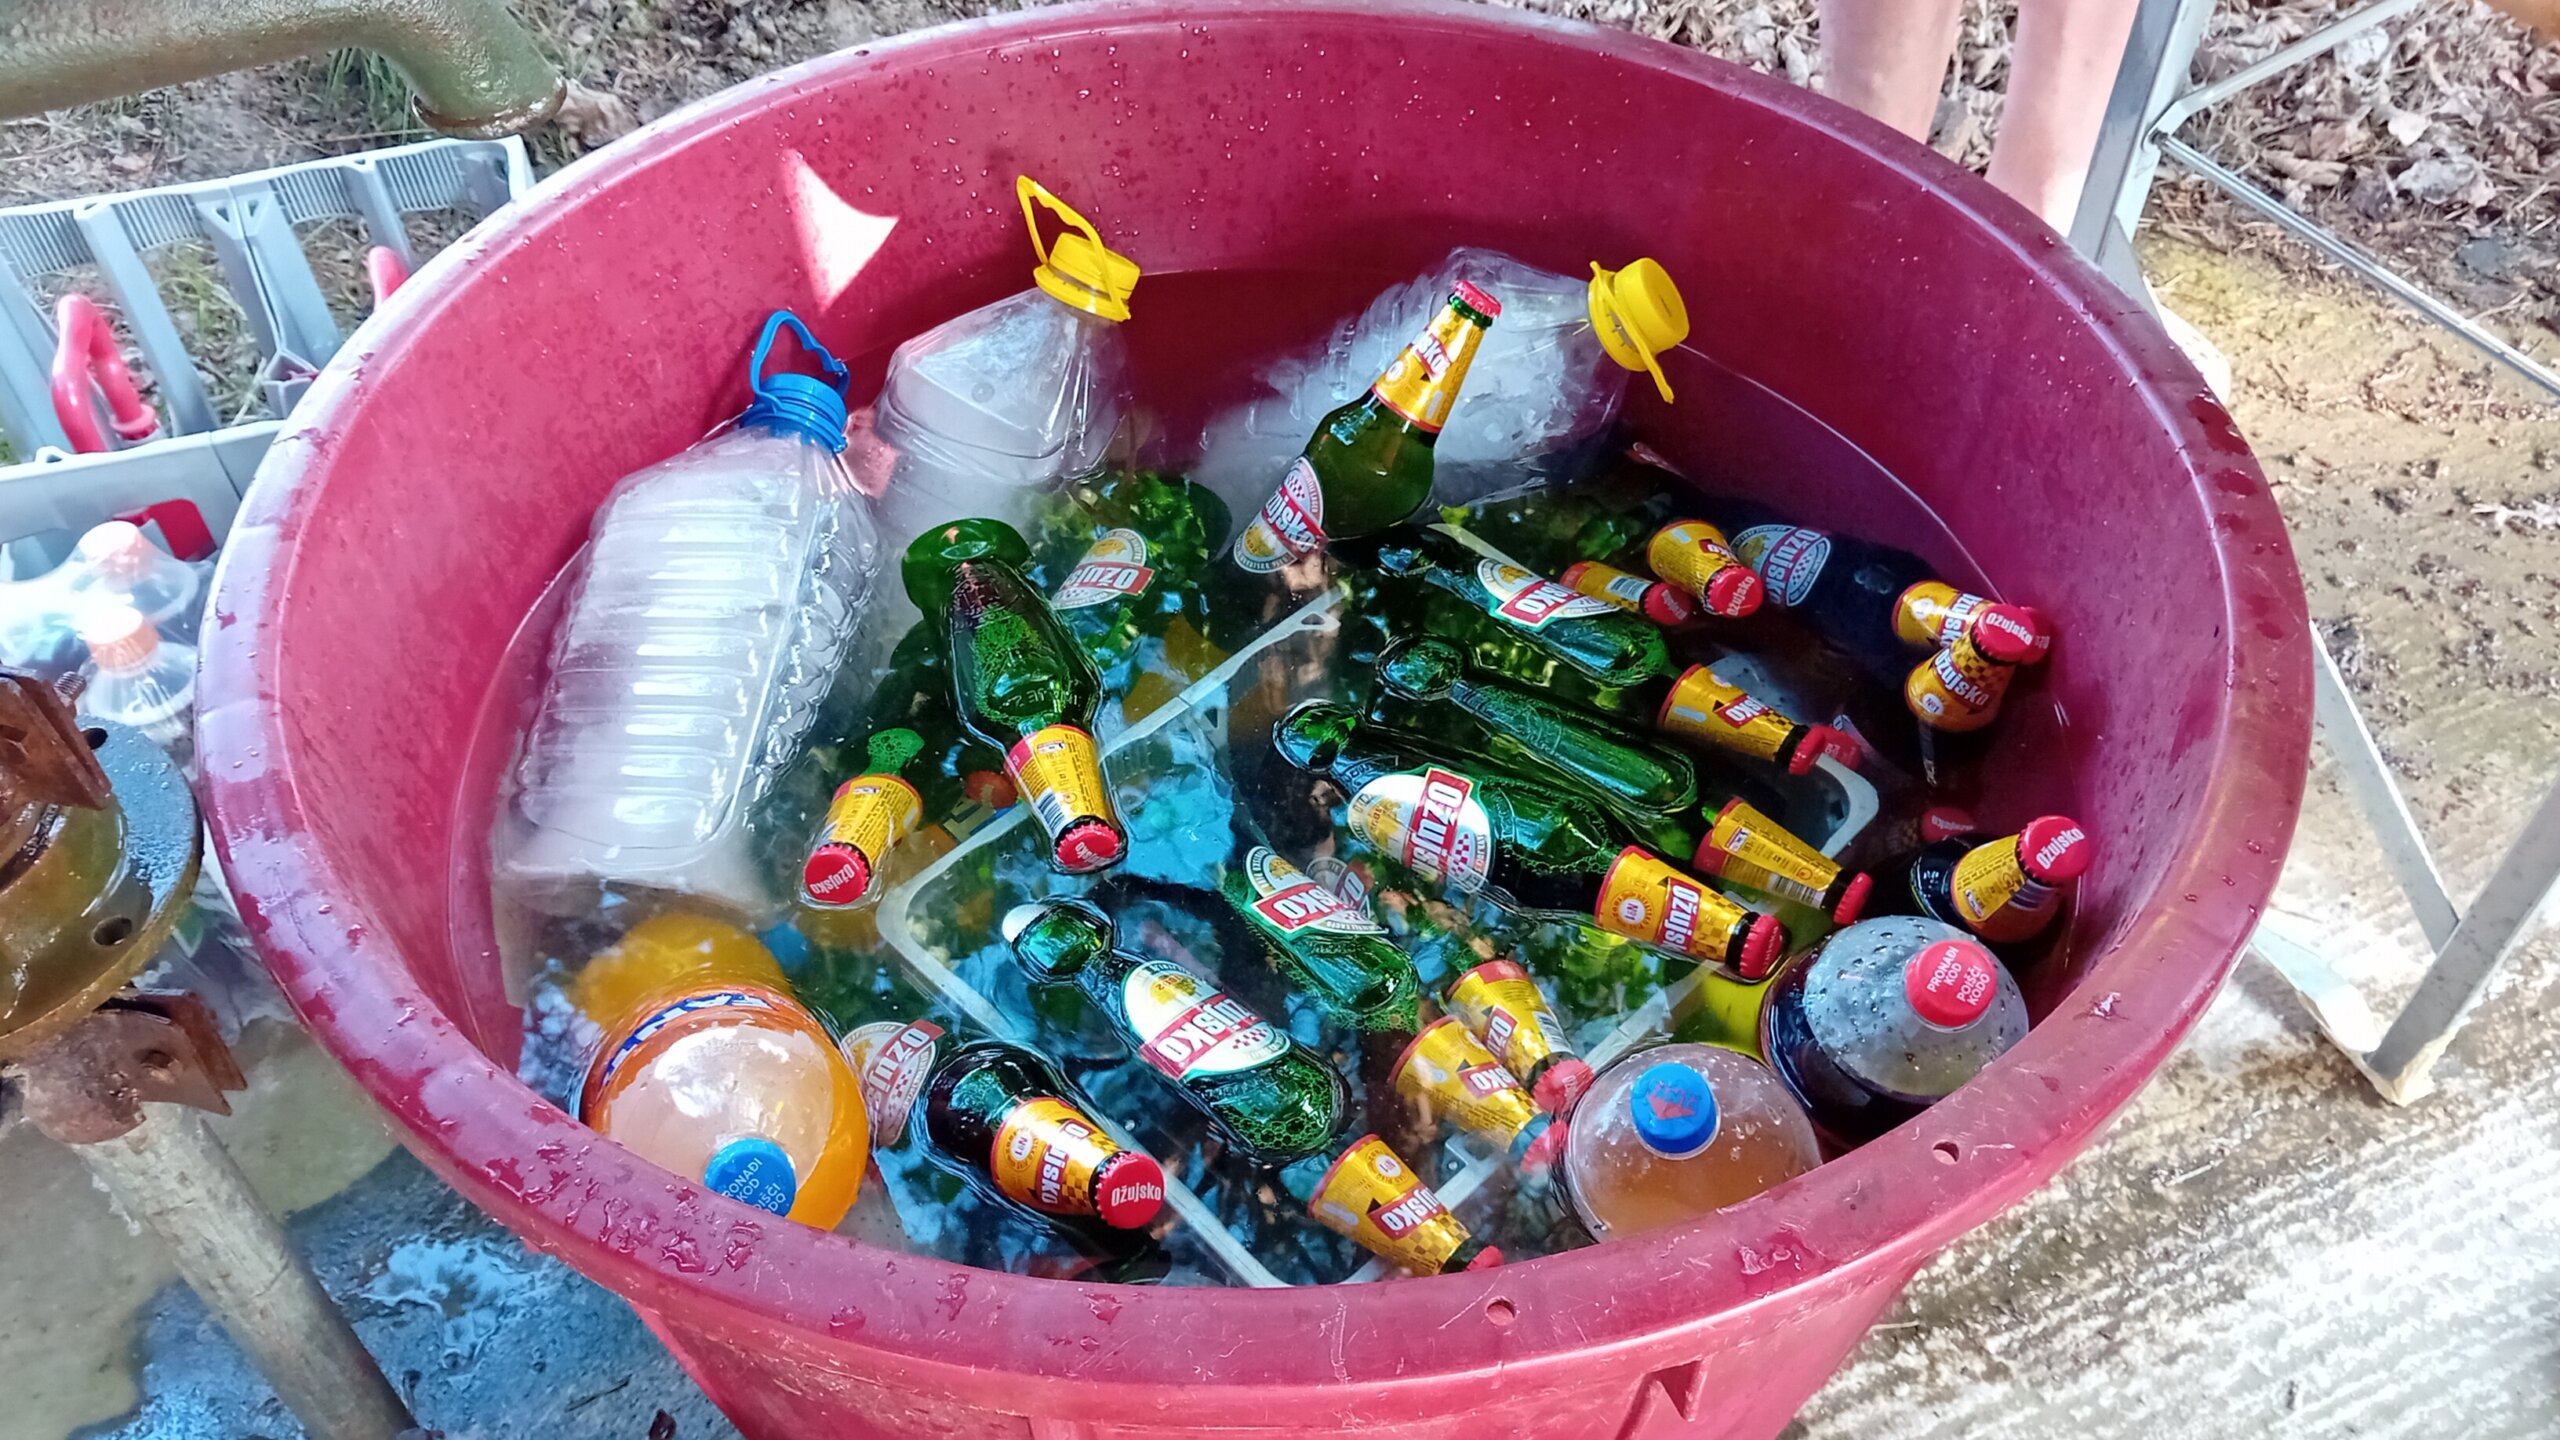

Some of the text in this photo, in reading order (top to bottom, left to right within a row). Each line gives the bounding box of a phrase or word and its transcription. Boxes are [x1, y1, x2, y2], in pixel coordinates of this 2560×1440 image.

[1265, 486, 1316, 554] žujsko
[1727, 575, 1755, 616] Ožujsko
[1942, 593, 1984, 648] Ožujsk
[1986, 612, 2033, 646] Ožujsko
[1934, 651, 1990, 706] Ožujsko
[2036, 828, 2086, 869] Ožujsko
[810, 864, 855, 895] Ožujsko
[1926, 945, 1960, 993] PRONAĐI
[1943, 962, 1963, 987] KOD
[1956, 964, 1982, 1002] POIŠČI
[1966, 972, 1990, 1006] KODO
[1154, 991, 1252, 1060] žujsko
[723, 1158, 763, 1199] RONAĐI
[1111, 1183, 1162, 1207] Ožujsko
[1384, 1187, 1439, 1231] ujsko
